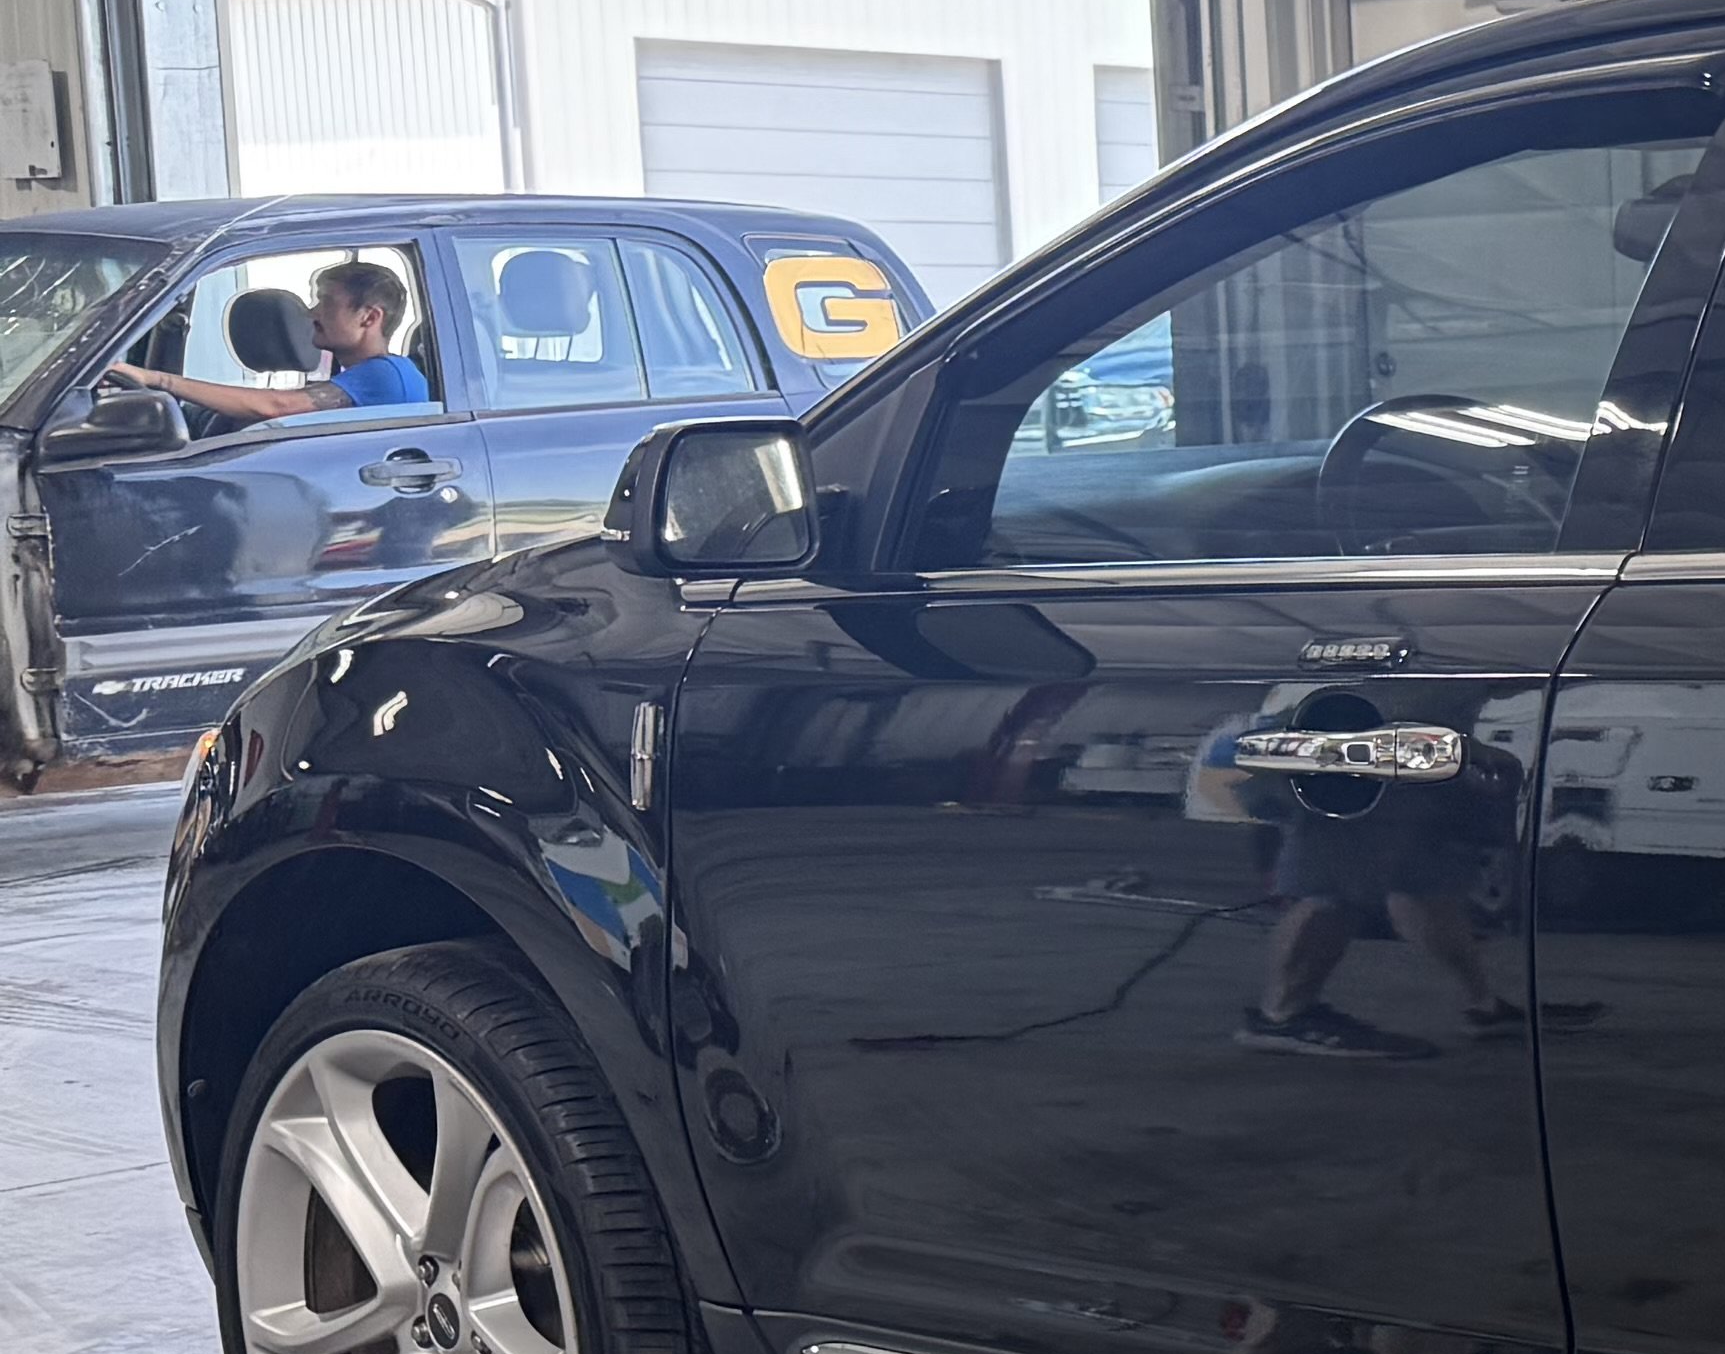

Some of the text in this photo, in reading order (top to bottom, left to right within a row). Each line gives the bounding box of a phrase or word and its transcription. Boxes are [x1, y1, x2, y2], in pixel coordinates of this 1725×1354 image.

[764, 256, 901, 359] G
[131, 667, 246, 693] TRACKER
[344, 988, 460, 1040] ARROYO
